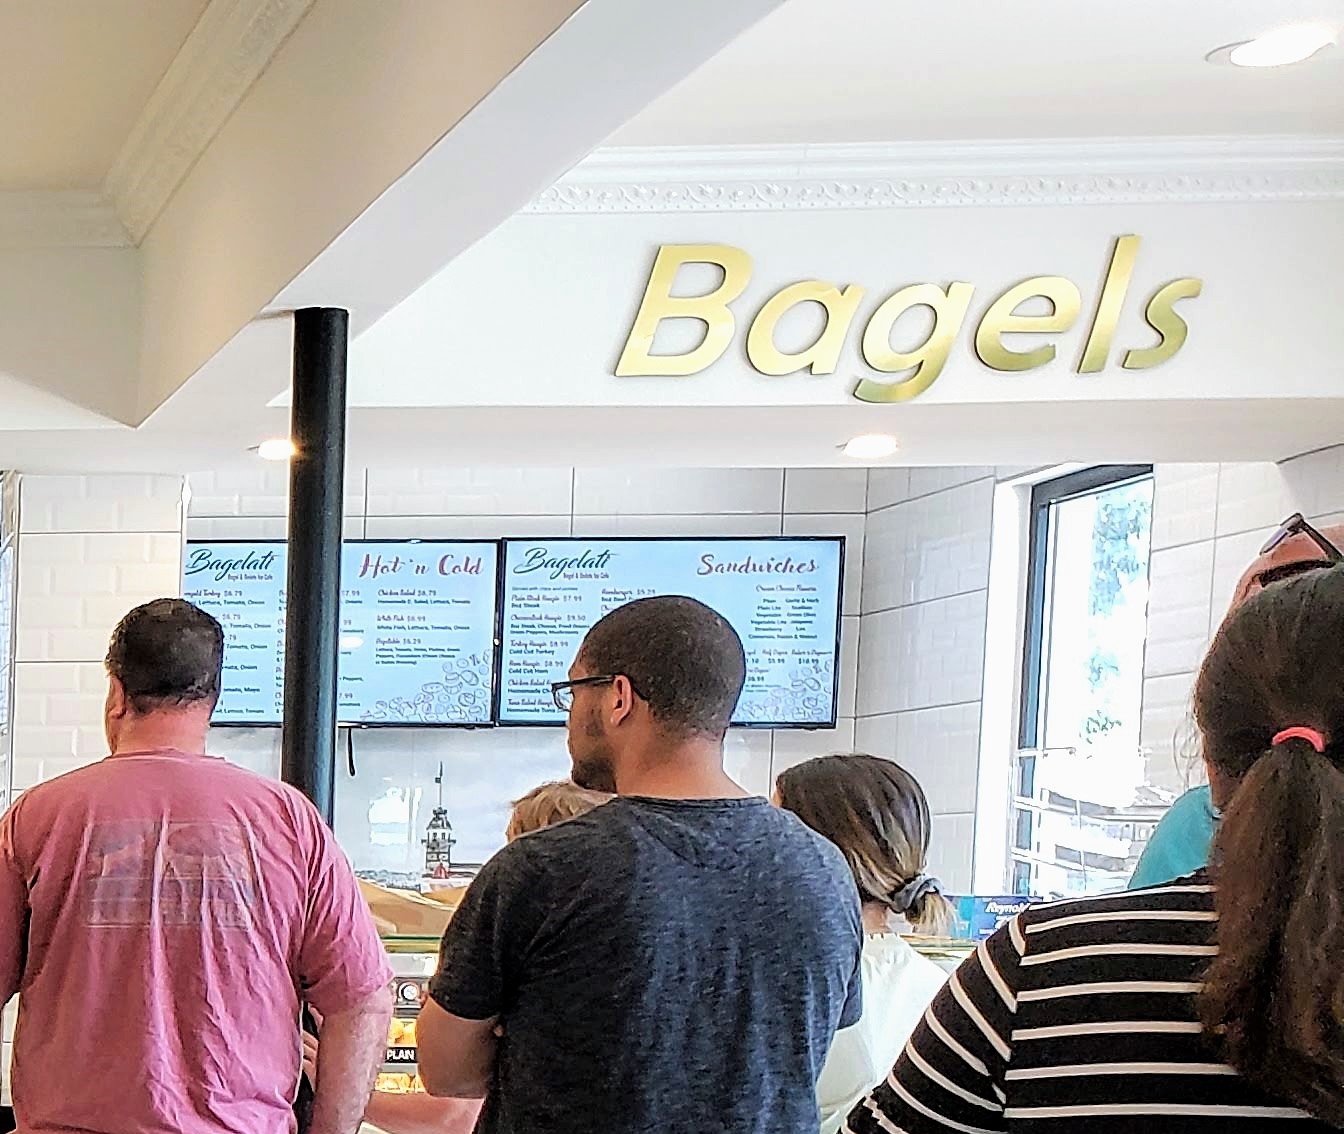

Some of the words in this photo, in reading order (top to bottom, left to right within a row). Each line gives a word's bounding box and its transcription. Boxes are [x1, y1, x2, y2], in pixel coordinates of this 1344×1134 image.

[614, 234, 1203, 403] Bagels
[184, 548, 278, 581] Bagelati
[359, 553, 406, 579] Hot
[438, 554, 482, 576] Cold
[513, 547, 614, 580] Bagelati
[697, 554, 819, 576] Sandwiches
[386, 1049, 415, 1061] PLAIN
